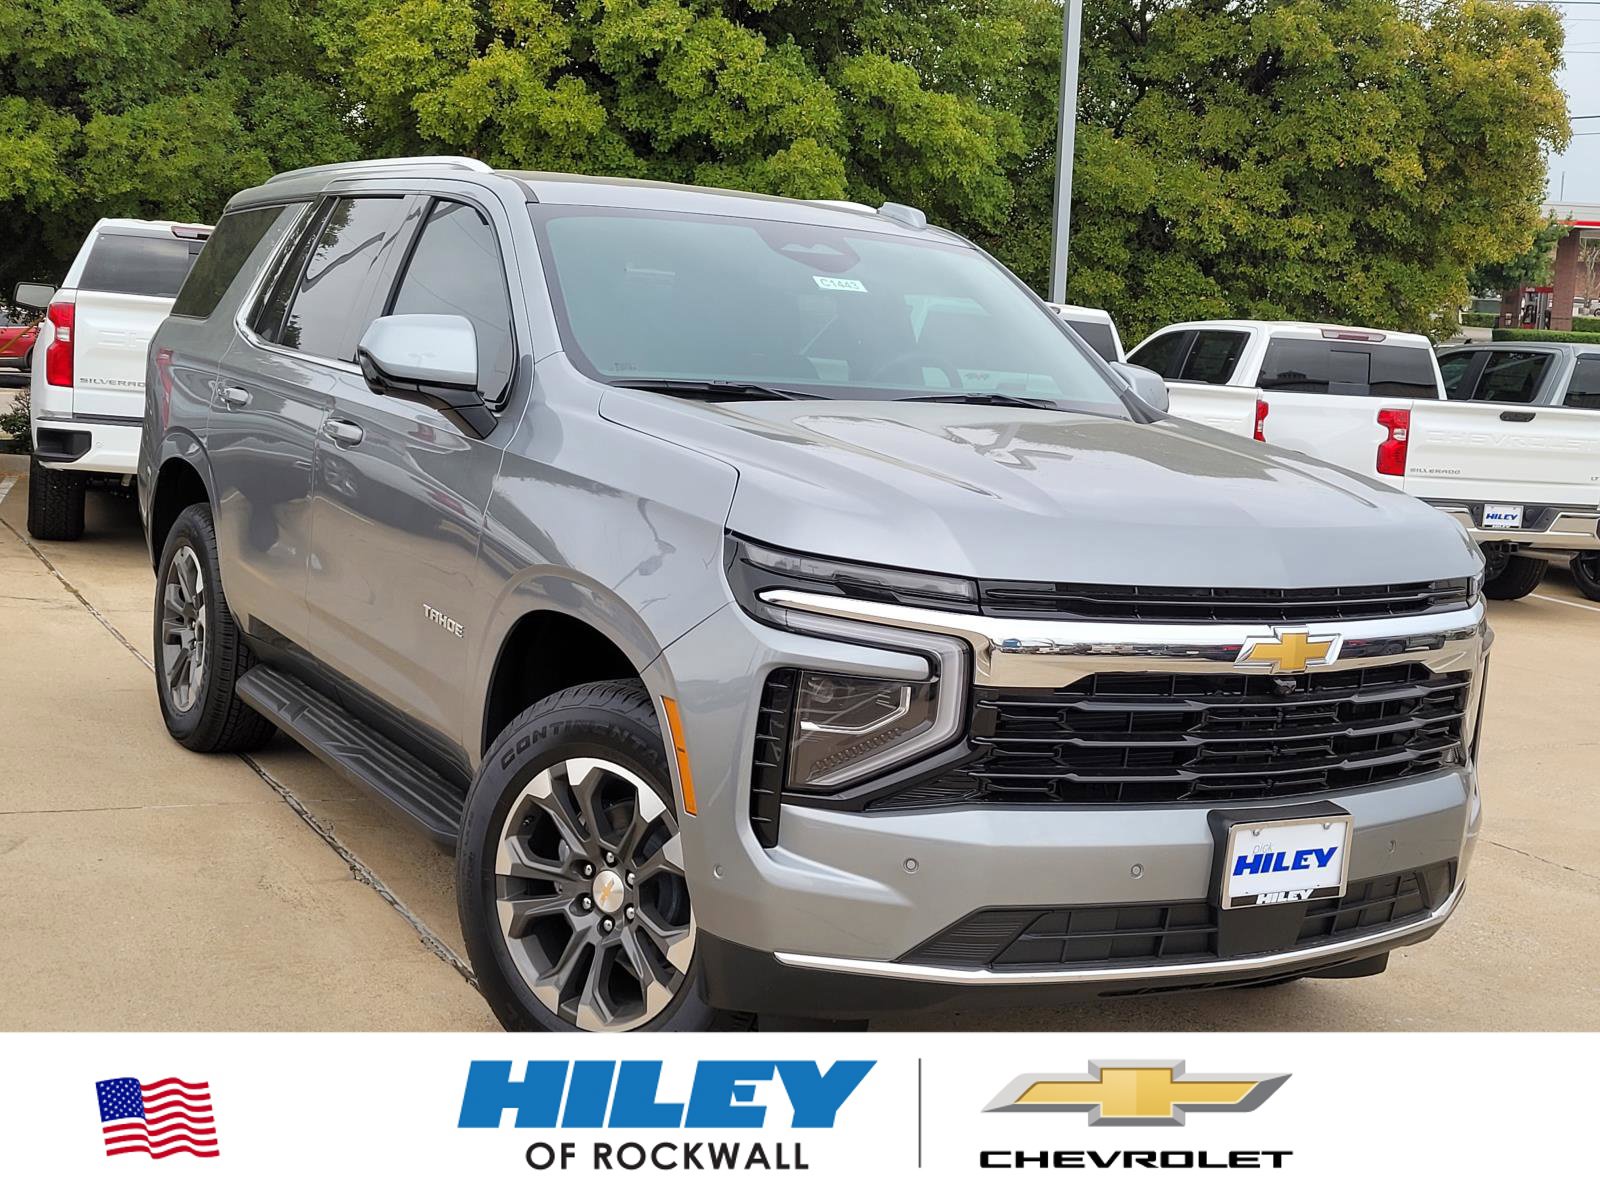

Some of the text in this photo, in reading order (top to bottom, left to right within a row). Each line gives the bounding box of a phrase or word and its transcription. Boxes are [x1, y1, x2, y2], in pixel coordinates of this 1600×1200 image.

[820, 279, 860, 289] C1443
[80, 378, 146, 387] SILVERAD
[423, 603, 464, 638] TAHOE
[1233, 847, 1338, 876] HILEY
[1256, 889, 1314, 904] HILEY
